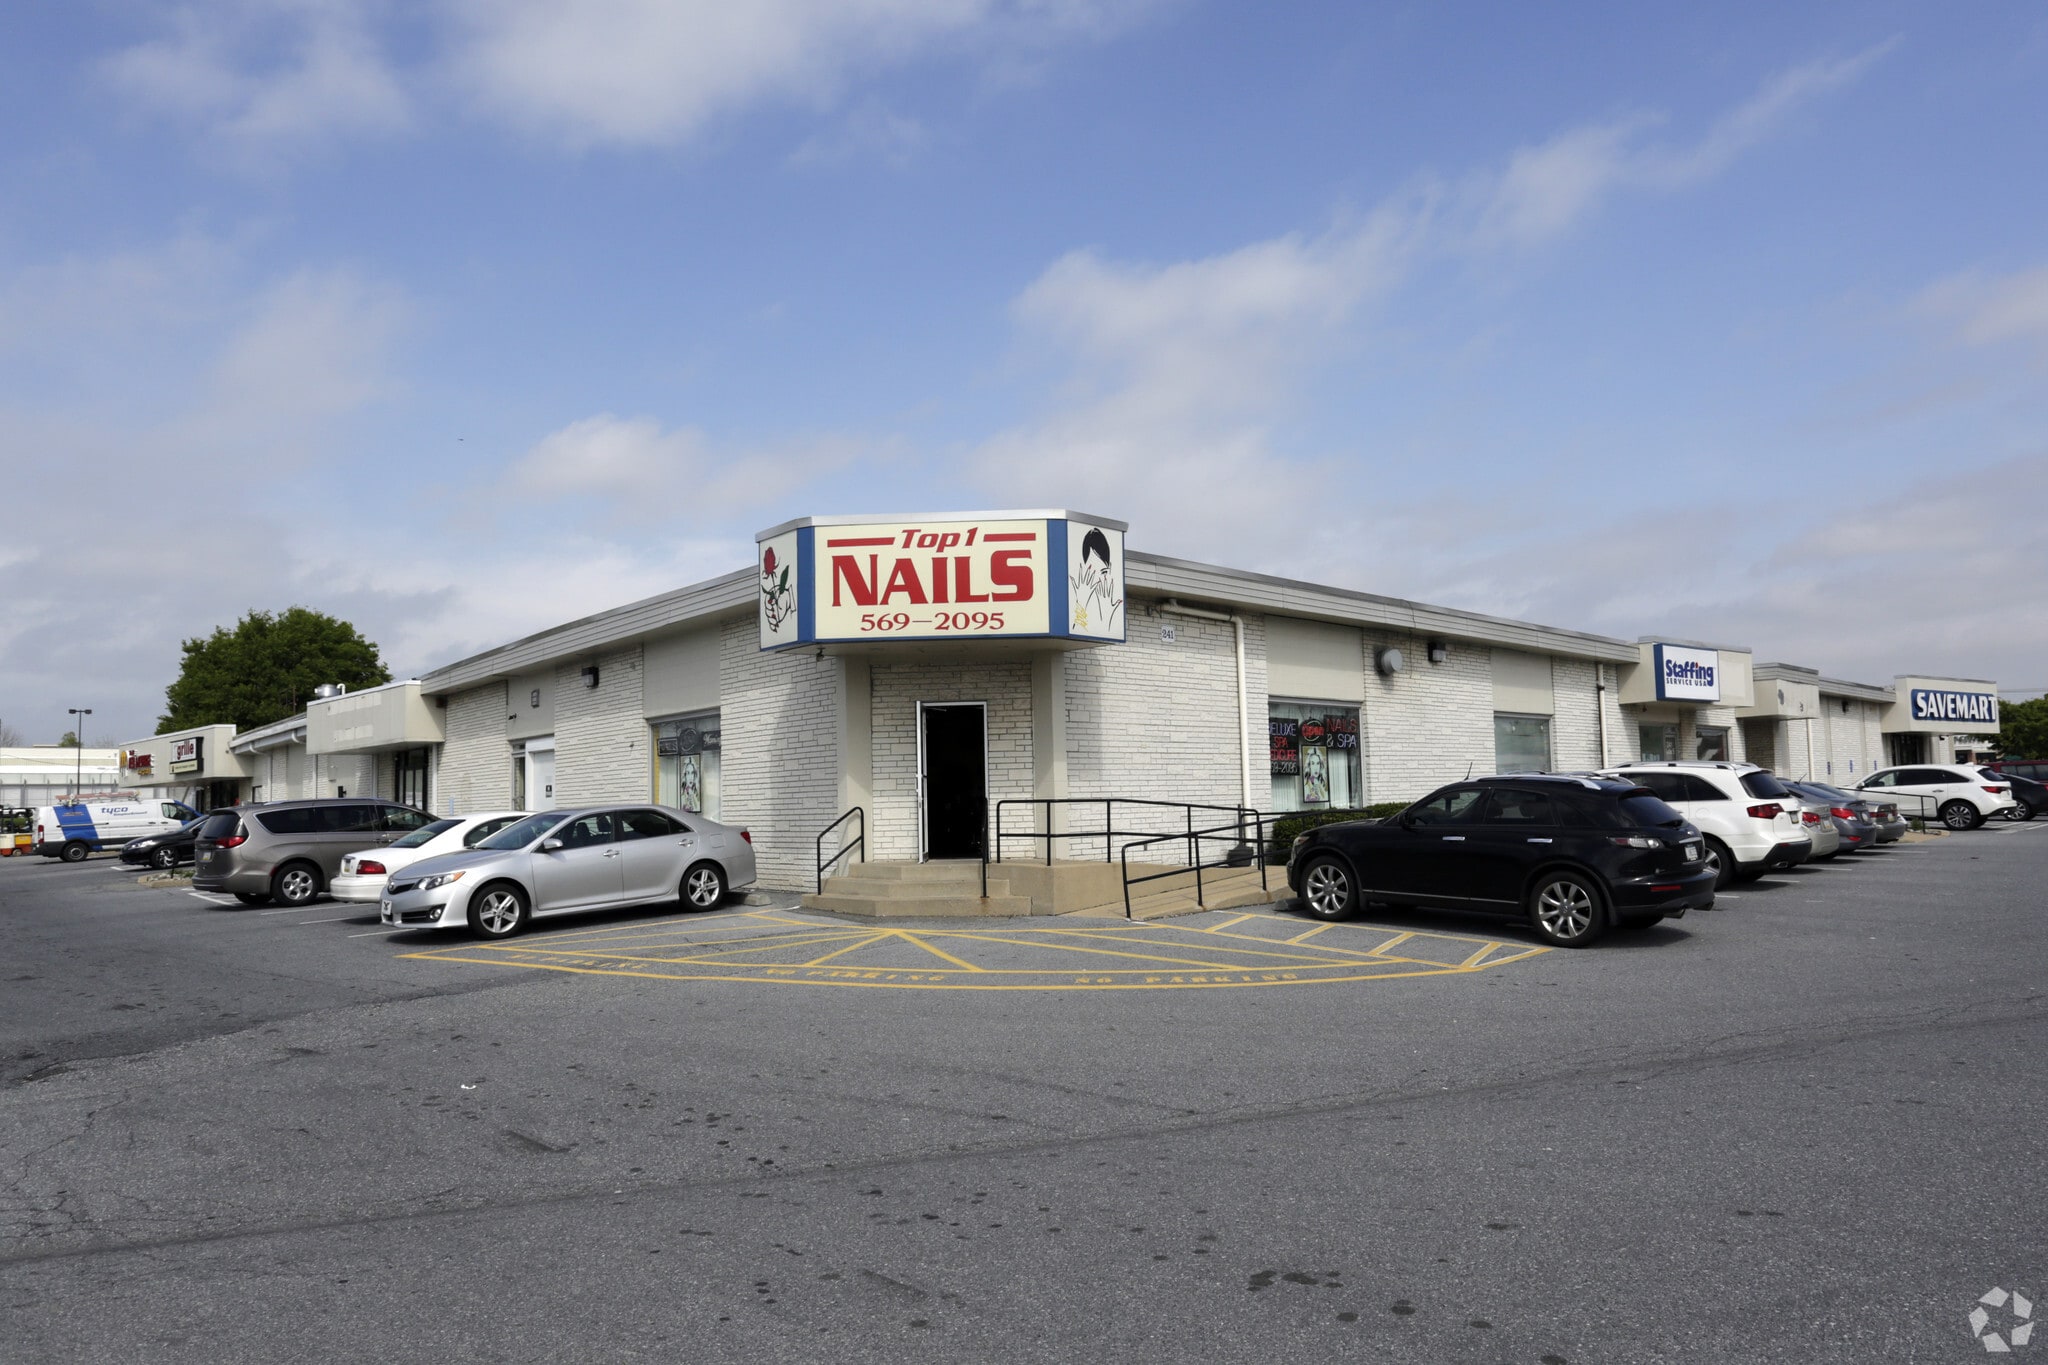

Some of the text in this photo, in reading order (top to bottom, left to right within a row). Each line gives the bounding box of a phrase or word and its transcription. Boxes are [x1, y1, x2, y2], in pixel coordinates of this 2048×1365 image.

[902, 528, 960, 553] Top
[832, 549, 1034, 607] NAILS
[861, 612, 1005, 632] 569-2095
[1162, 629, 1173, 639] 241
[1666, 659, 1714, 687] Staffing
[1666, 677, 1692, 686] SERVICE
[1916, 692, 1996, 720] SAVEMART
[1326, 719, 1357, 733] NAILS
[1274, 736, 1289, 748] SPA
[1337, 733, 1356, 749] SPA
[177, 740, 194, 760] grille
[101, 807, 128, 815] tyco
[1145, 973, 1298, 984] PARKING
